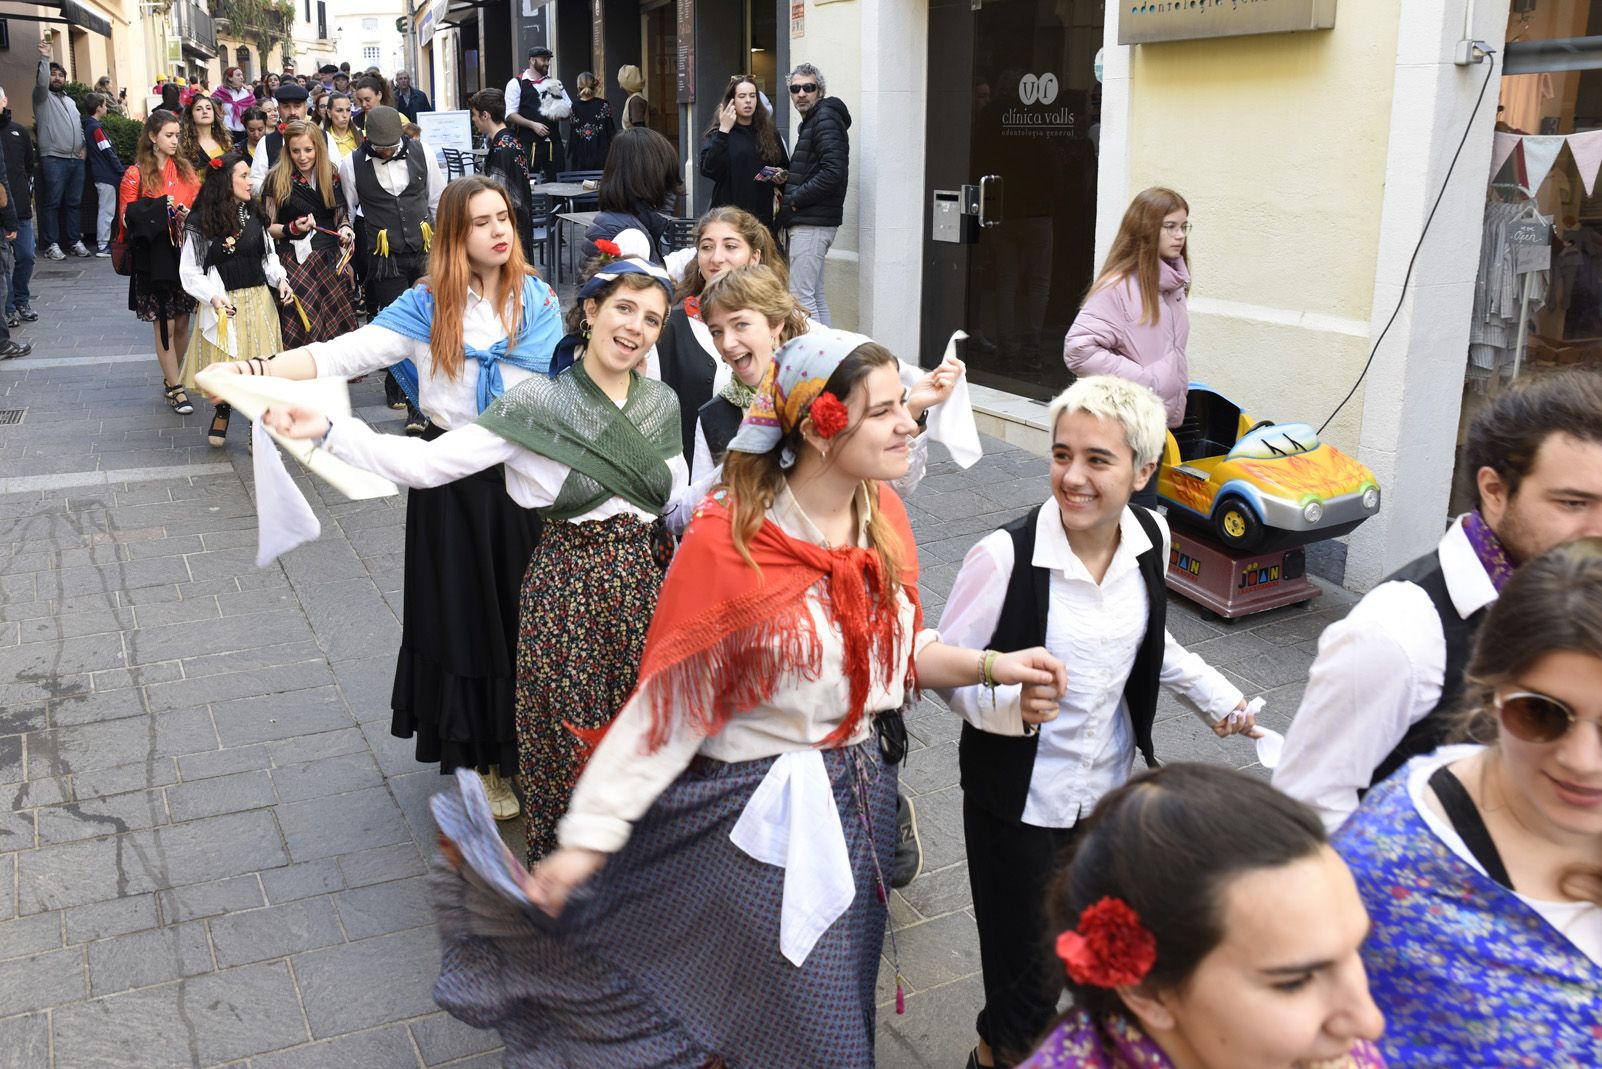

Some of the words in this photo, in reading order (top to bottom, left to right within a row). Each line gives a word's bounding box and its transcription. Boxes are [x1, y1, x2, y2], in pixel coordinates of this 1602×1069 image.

[1002, 108, 1042, 124] clínica
[1045, 107, 1075, 124] valls
[1170, 549, 1200, 576] OAN
